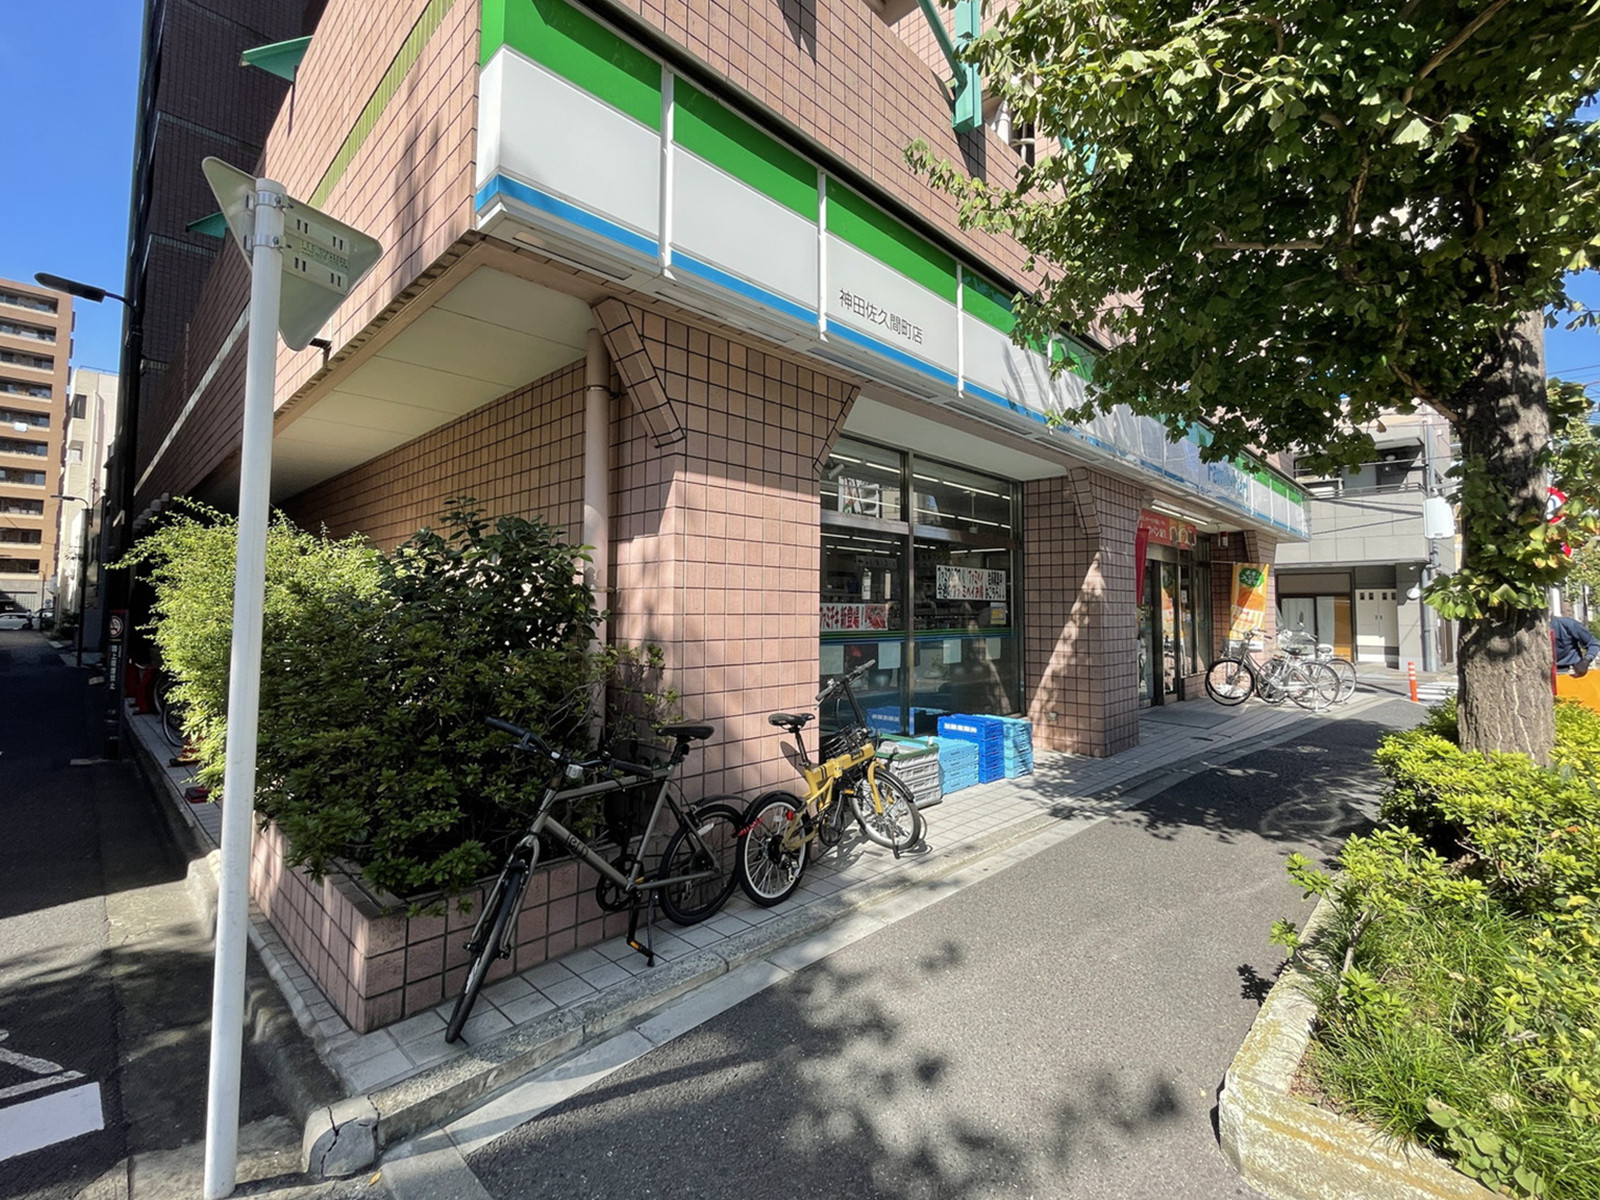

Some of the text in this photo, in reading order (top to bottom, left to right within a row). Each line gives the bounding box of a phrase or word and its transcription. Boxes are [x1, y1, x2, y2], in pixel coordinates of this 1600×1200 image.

[839, 287, 923, 344] 神田佐久間町店
